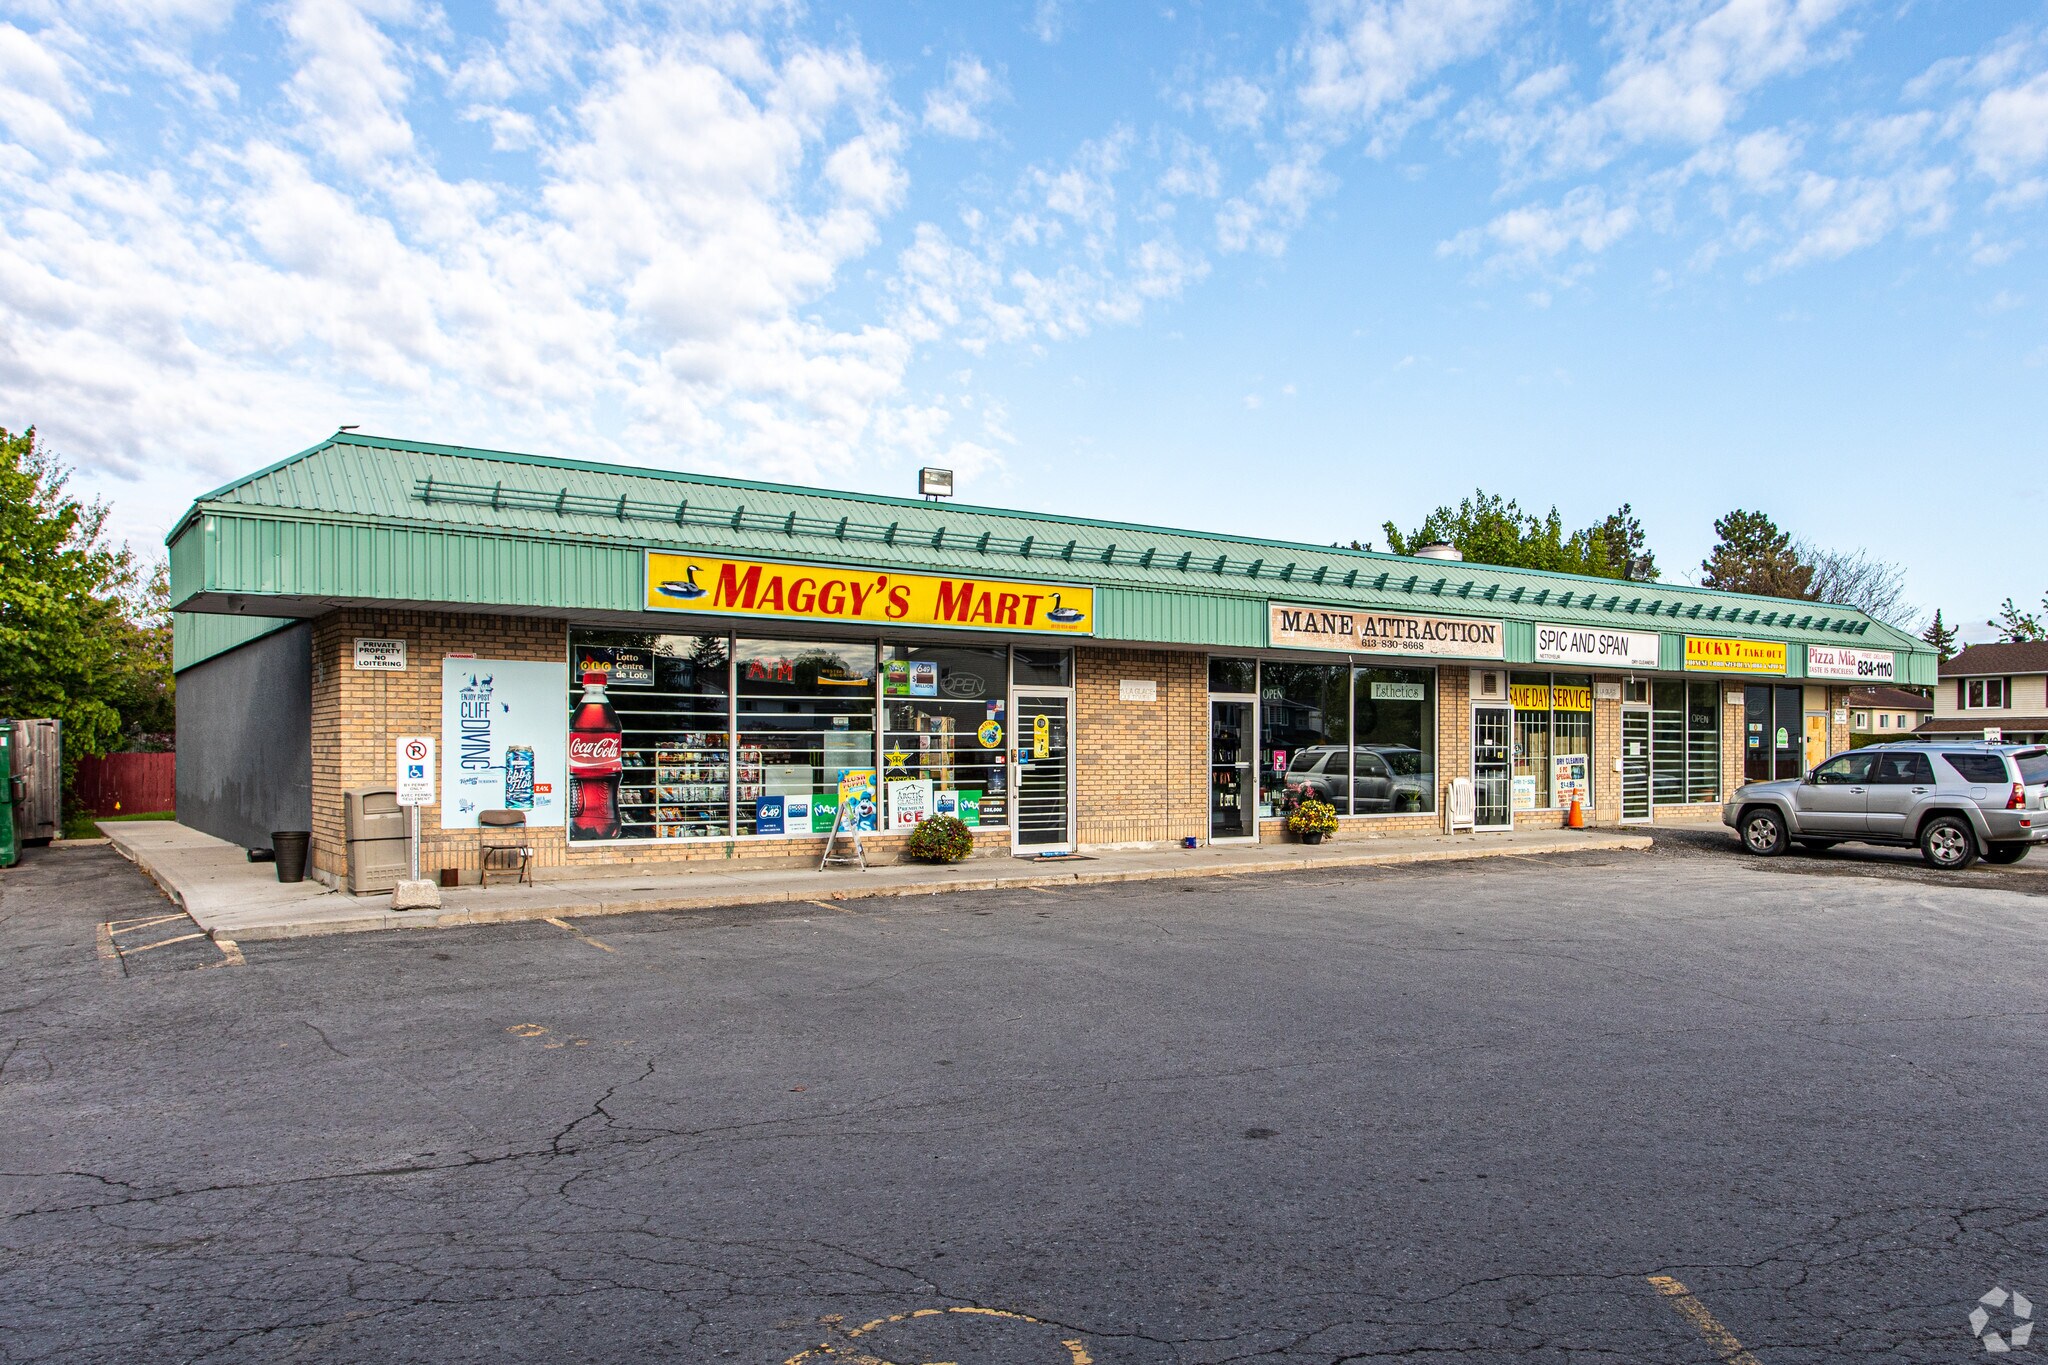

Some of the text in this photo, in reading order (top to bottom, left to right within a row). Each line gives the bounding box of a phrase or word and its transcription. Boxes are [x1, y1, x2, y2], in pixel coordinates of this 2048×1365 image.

[713, 563, 1044, 625] MAGGY'S MART
[1281, 610, 1496, 643] MANE ATTRACTION
[1361, 638, 1424, 650] 613-830-8668
[1540, 629, 1629, 656] SPIC AND SPAN
[1688, 640, 1782, 658] LUCKY 7 TAKE OUT
[616, 653, 639, 662] Lotto
[1809, 648, 1856, 666] Pizza Mia
[616, 662, 644, 671] Centre
[748, 656, 794, 681] ATM
[1830, 667, 1854, 675] PRICELESS
[616, 671, 648, 679] de Loto
[943, 677, 985, 692] OPEN
[1375, 684, 1419, 699] Esthetics
[461, 693, 476, 701] ENJOY
[1262, 688, 1283, 700] OPEN
[1510, 687, 1549, 707] SAME DAY
[1553, 687, 1590, 709] SERVICE
[461, 701, 490, 718] CLIFF
[1691, 713, 1709, 724] OPEN
[461, 720, 490, 770] DIVING
[570, 738, 619, 758] Coca-Cola
[1565, 757, 1585, 765] CLEANING
[897, 811, 924, 823] ICE
